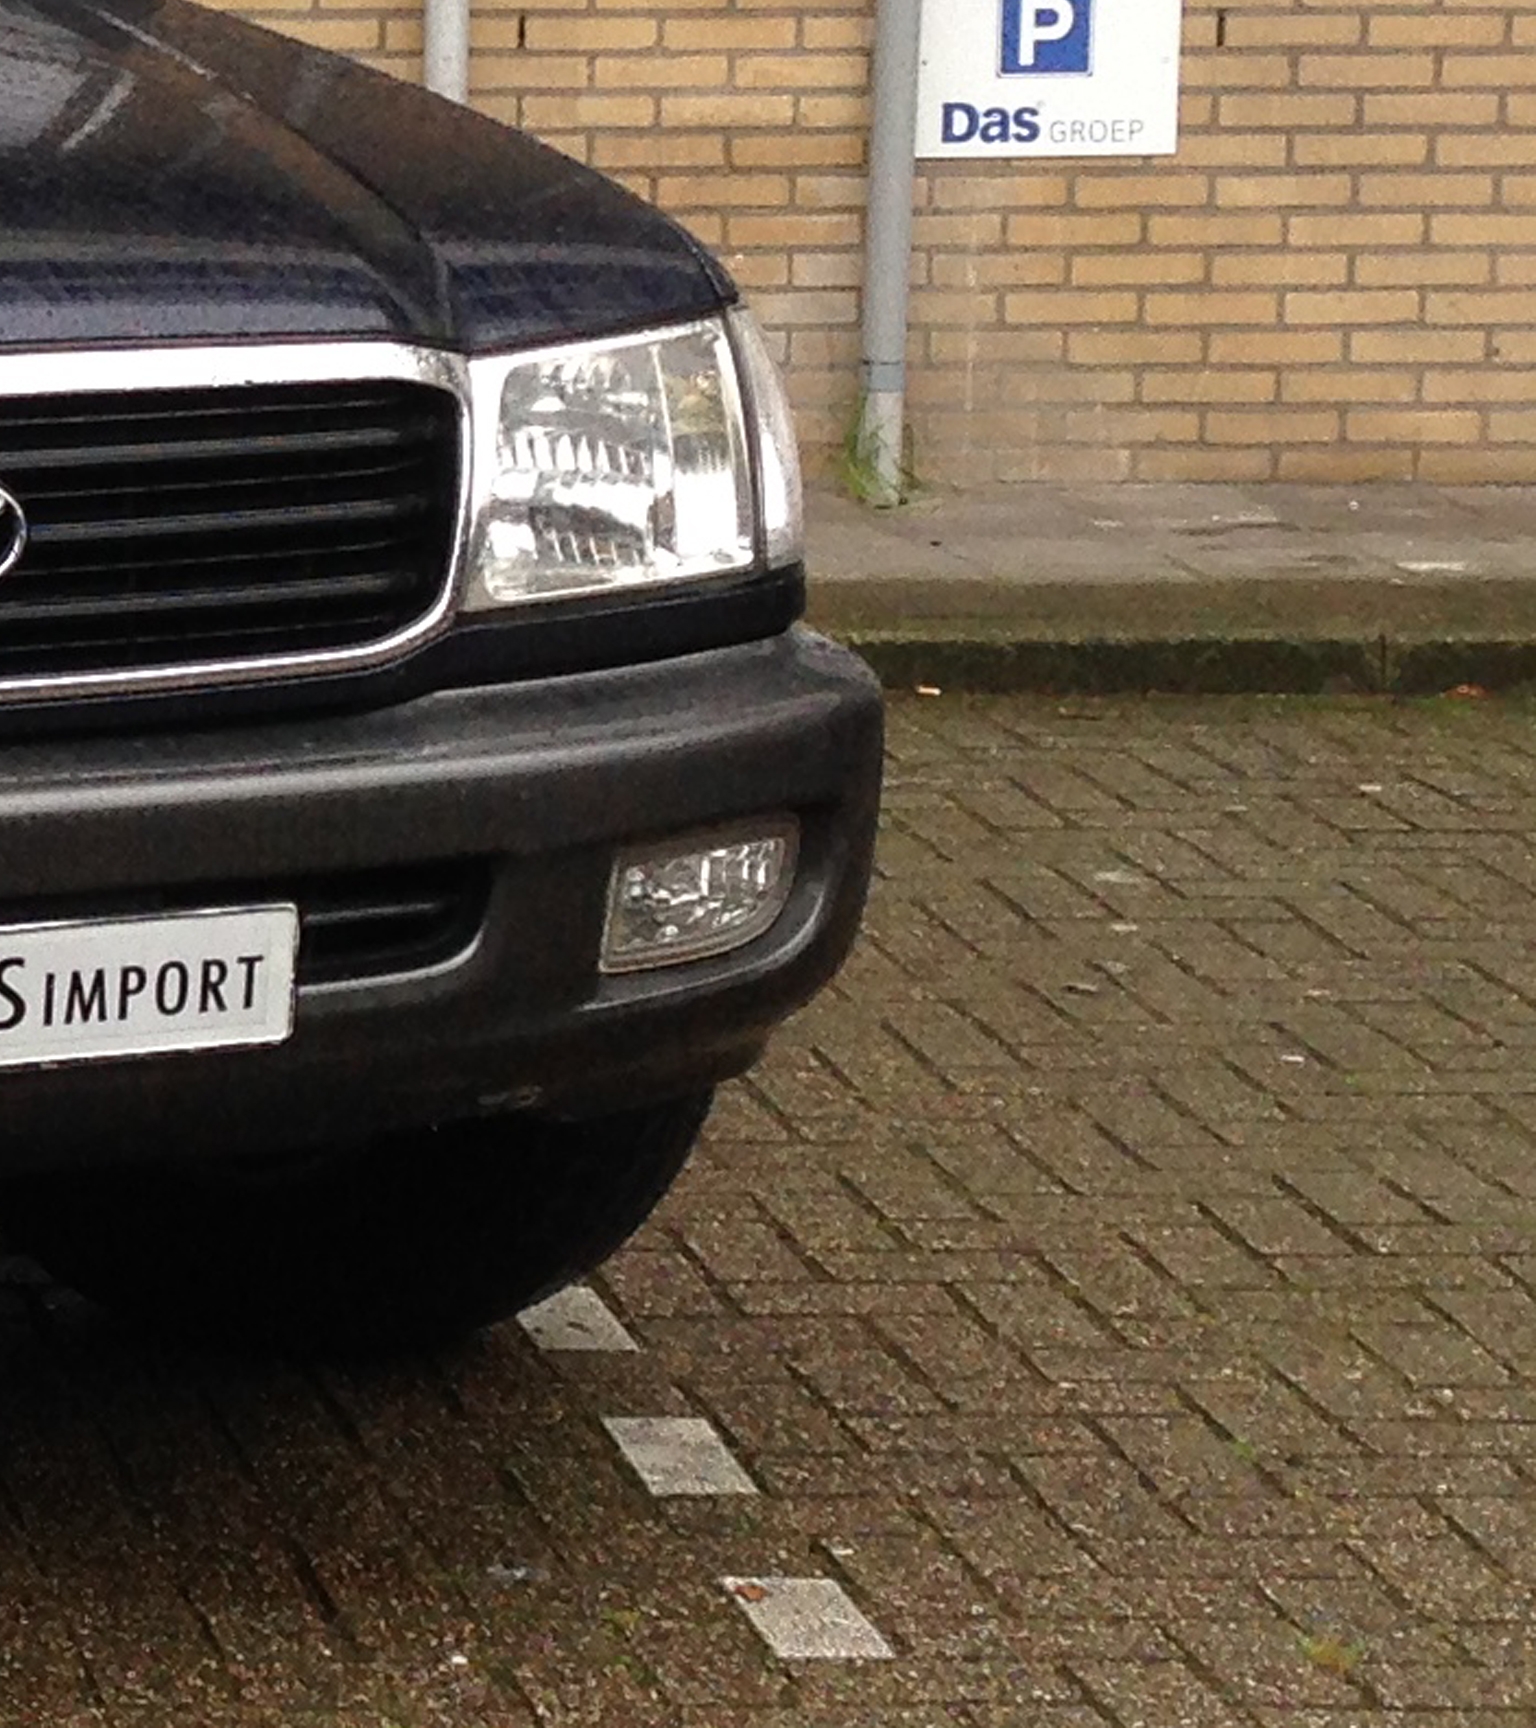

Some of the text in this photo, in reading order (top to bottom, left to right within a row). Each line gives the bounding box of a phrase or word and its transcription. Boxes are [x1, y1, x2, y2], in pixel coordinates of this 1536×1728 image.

[940, 101, 1144, 144] Das GROEP
[43, 955, 264, 1027] IMPORT
